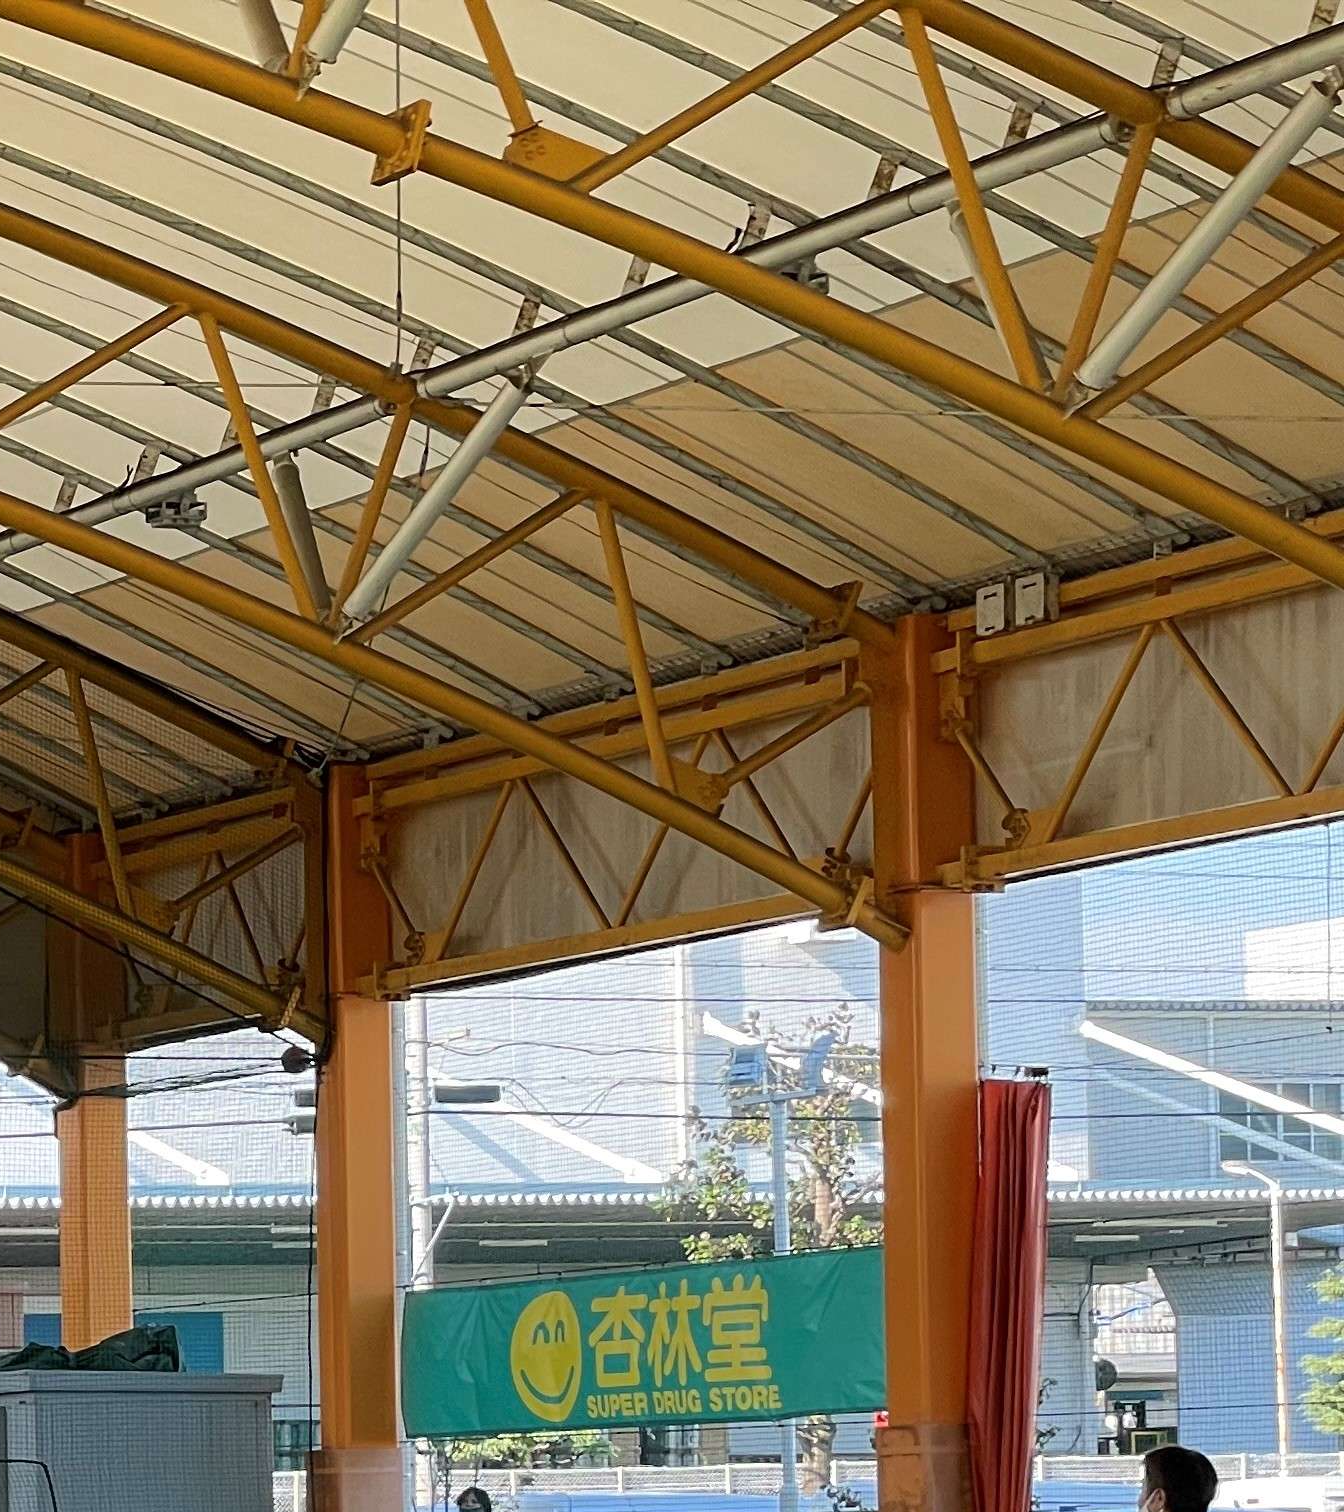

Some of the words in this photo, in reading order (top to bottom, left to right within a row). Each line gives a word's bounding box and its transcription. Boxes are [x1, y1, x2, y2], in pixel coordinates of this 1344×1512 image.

[588, 1273, 772, 1388] 杏林堂
[586, 1391, 649, 1419] SUPER
[655, 1388, 702, 1415] DRUG
[708, 1384, 783, 1412] STORE
